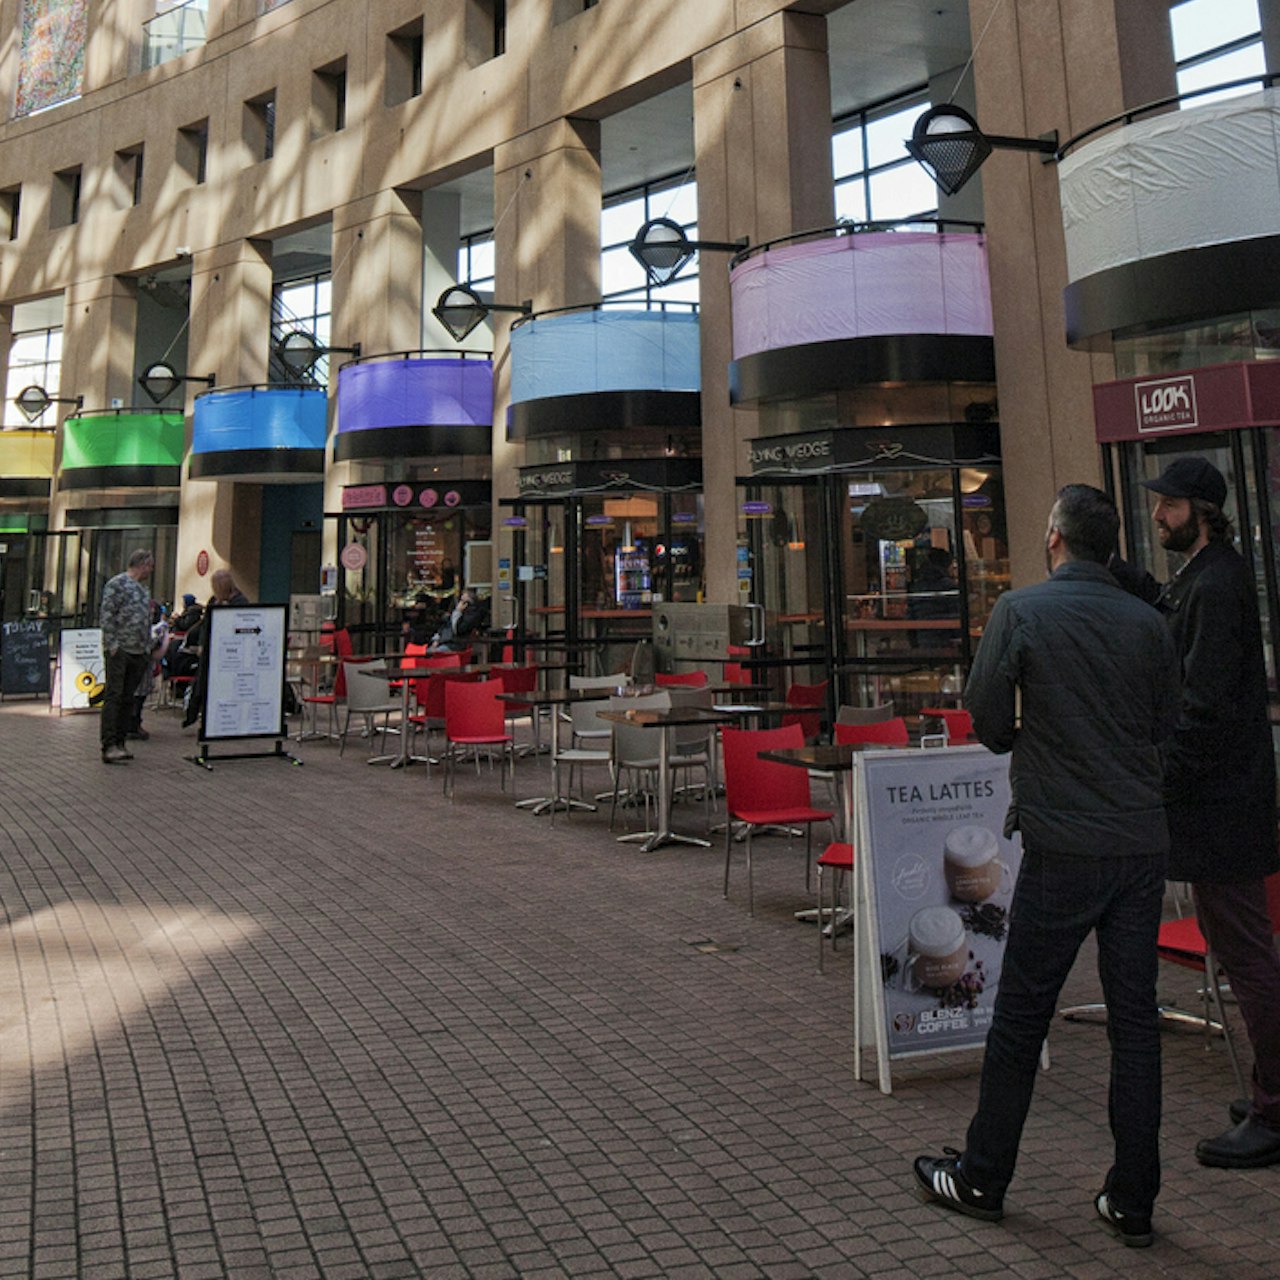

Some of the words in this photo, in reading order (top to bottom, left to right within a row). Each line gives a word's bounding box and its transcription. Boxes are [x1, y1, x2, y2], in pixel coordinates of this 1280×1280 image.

[1142, 385, 1190, 415] LOOK
[747, 446, 783, 463] FLYING
[784, 441, 830, 458] WEDGE
[3, 621, 44, 636] TODAY
[887, 785, 923, 804] TEA
[930, 780, 995, 801] LATTES
[902, 815, 930, 825] ORGANIC
[920, 1007, 964, 1022] BLENZ
[917, 1018, 968, 1034] COFFEE
